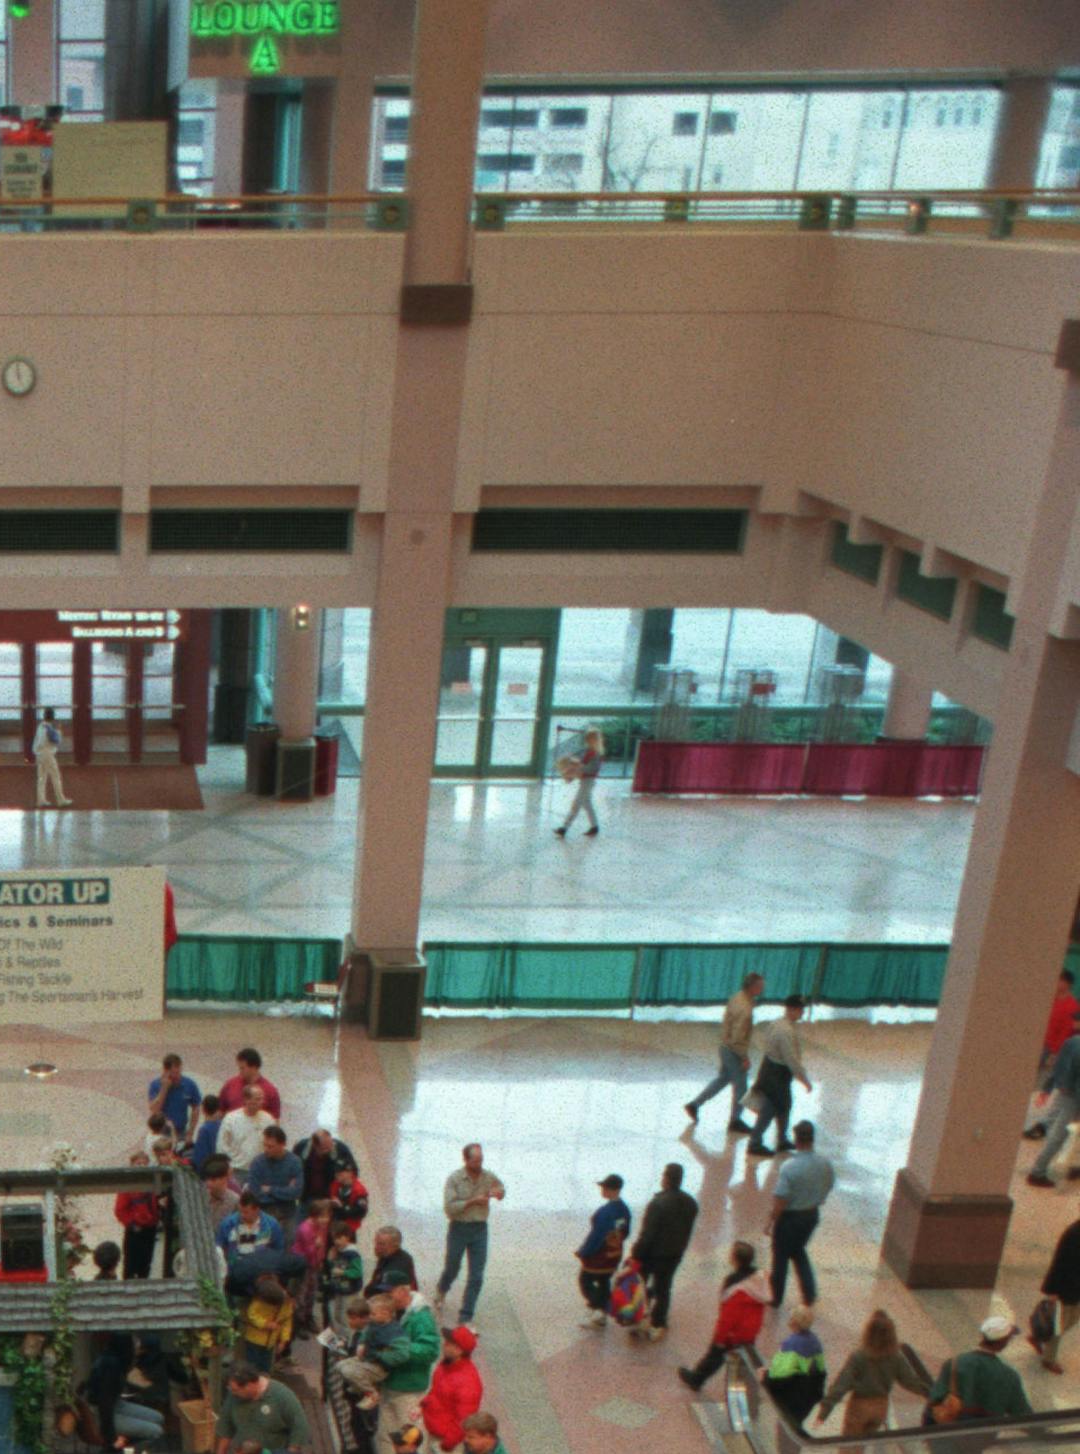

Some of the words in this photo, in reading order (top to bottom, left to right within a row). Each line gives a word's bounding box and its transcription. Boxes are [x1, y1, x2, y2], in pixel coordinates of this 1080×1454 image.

[190, 0, 341, 35] LOUNGE
[249, 35, 280, 75] A
[72, 881, 107, 903] UP
[28, 916, 37, 928] &
[46, 915, 113, 927] Seminars
[15, 938, 35, 951] The
[39, 937, 63, 951] Wild
[5, 956, 14, 969] &
[8, 990, 29, 1002] The
